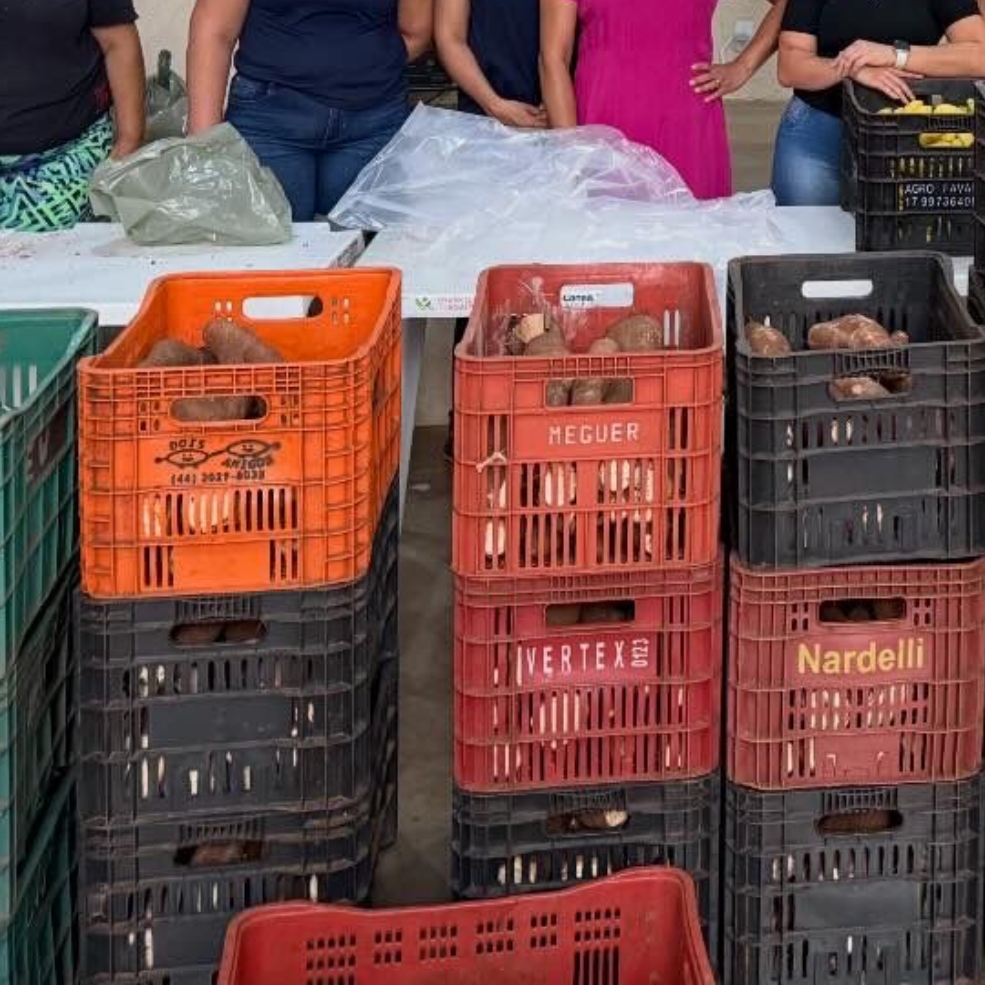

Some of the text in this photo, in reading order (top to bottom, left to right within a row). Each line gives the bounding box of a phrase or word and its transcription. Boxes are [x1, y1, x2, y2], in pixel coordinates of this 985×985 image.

[942, 181, 975, 194] FAVA
[920, 196, 975, 207] 9973640
[549, 422, 639, 445] MEGUER
[526, 640, 625, 677] VERTEX
[798, 637, 924, 674] Nardelli
